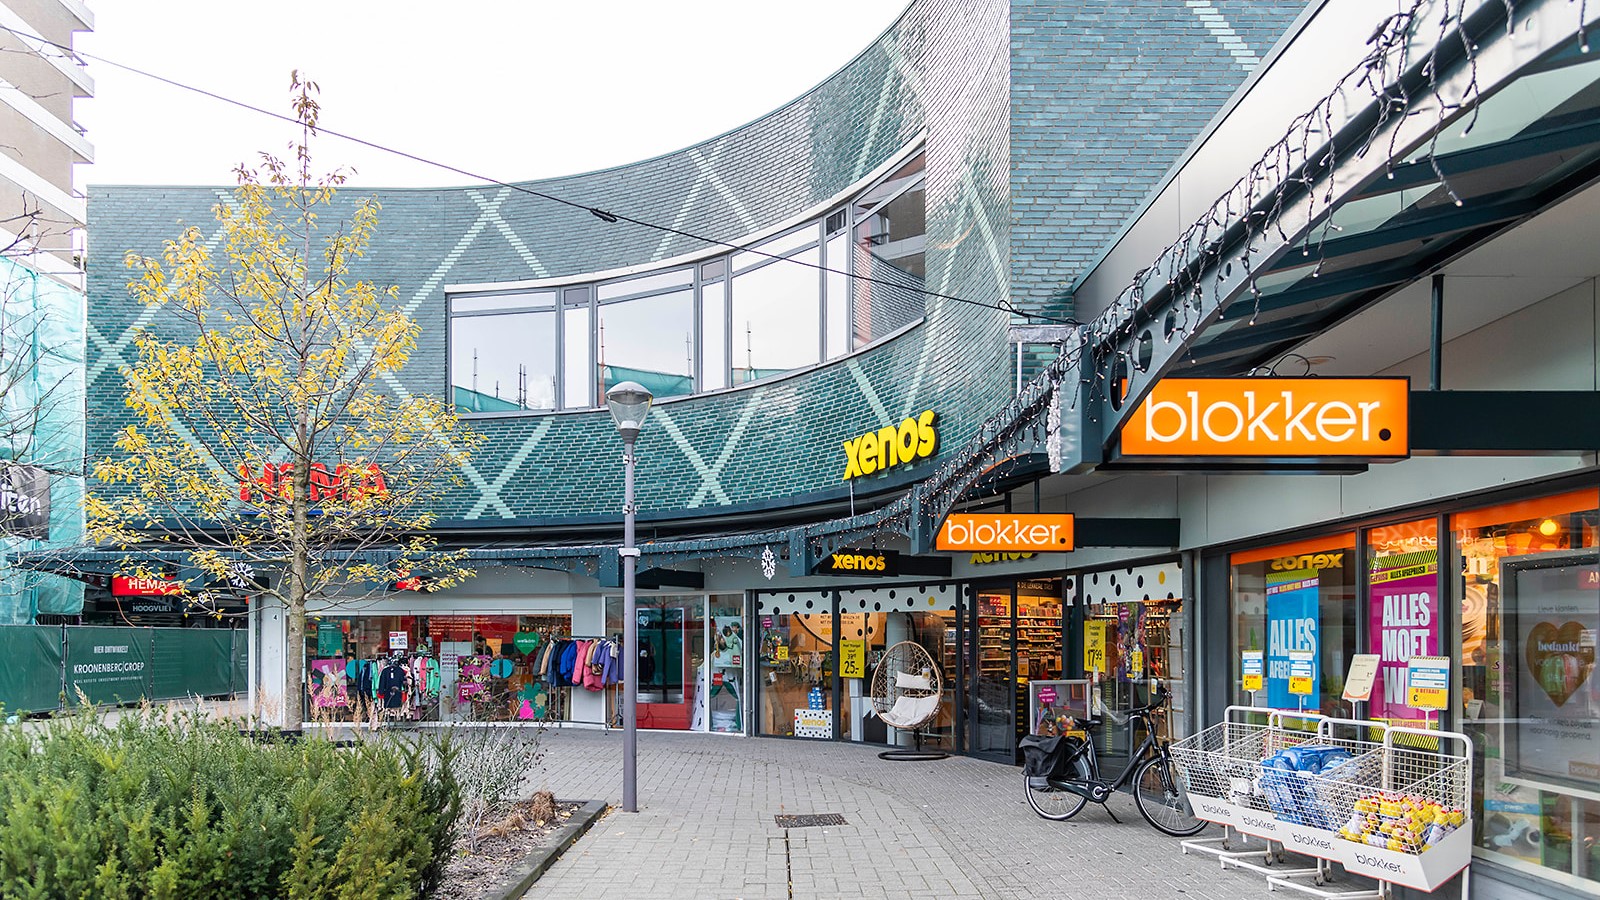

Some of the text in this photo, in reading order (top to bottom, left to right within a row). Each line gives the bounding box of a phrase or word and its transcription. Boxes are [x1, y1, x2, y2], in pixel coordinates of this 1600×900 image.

[1145, 390, 1392, 443] blokker.
[842, 410, 937, 481] xenos
[945, 519, 1066, 545] blokker.
[832, 554, 886, 571] xenos
[128, 578, 167, 590] HEMA
[1382, 592, 1431, 627] ALLES
[1269, 617, 1317, 657] ALLES
[1291, 832, 1335, 851] blokker.
[1354, 852, 1406, 874] blokker.
